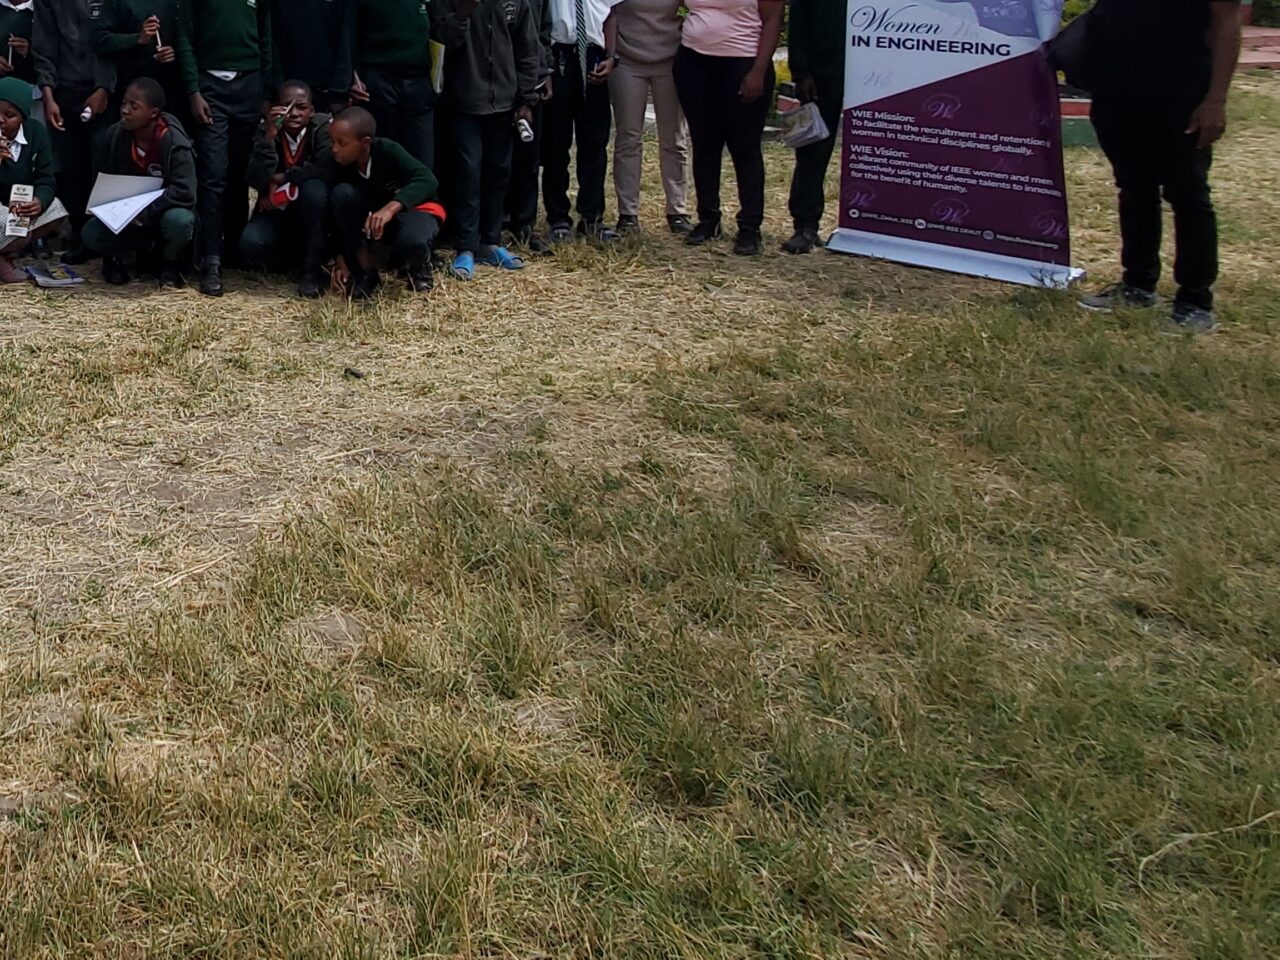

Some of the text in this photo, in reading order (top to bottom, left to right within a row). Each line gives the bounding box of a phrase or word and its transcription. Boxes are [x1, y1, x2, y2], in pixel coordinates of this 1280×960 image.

[851, 4, 942, 35] Women
[852, 35, 1011, 56] IN ENGINEERING
[852, 109, 915, 123] WIE Mission:
[851, 129, 885, 138] women
[887, 131, 895, 139] in
[897, 133, 938, 144] technical
[940, 139, 991, 150] disciplines
[863, 120, 902, 130] facilitate
[904, 124, 919, 132] the
[920, 126, 977, 139] recruitment
[979, 133, 998, 141] and
[850, 144, 872, 154] WIE
[849, 163, 896, 174] collectively
[897, 169, 921, 179] using
[922, 171, 943, 180] their
[979, 178, 1011, 189] talents
[1012, 183, 1023, 191] to
[851, 170, 863, 178] for
[864, 172, 879, 180] the
[880, 174, 911, 185] benefit
[858, 155, 888, 164] vibrant
[889, 159, 939, 172] community
[951, 166, 971, 175] IEEE
[972, 170, 1009, 180] women
[1010, 174, 1029, 183] and
[1031, 179, 1054, 187] men
